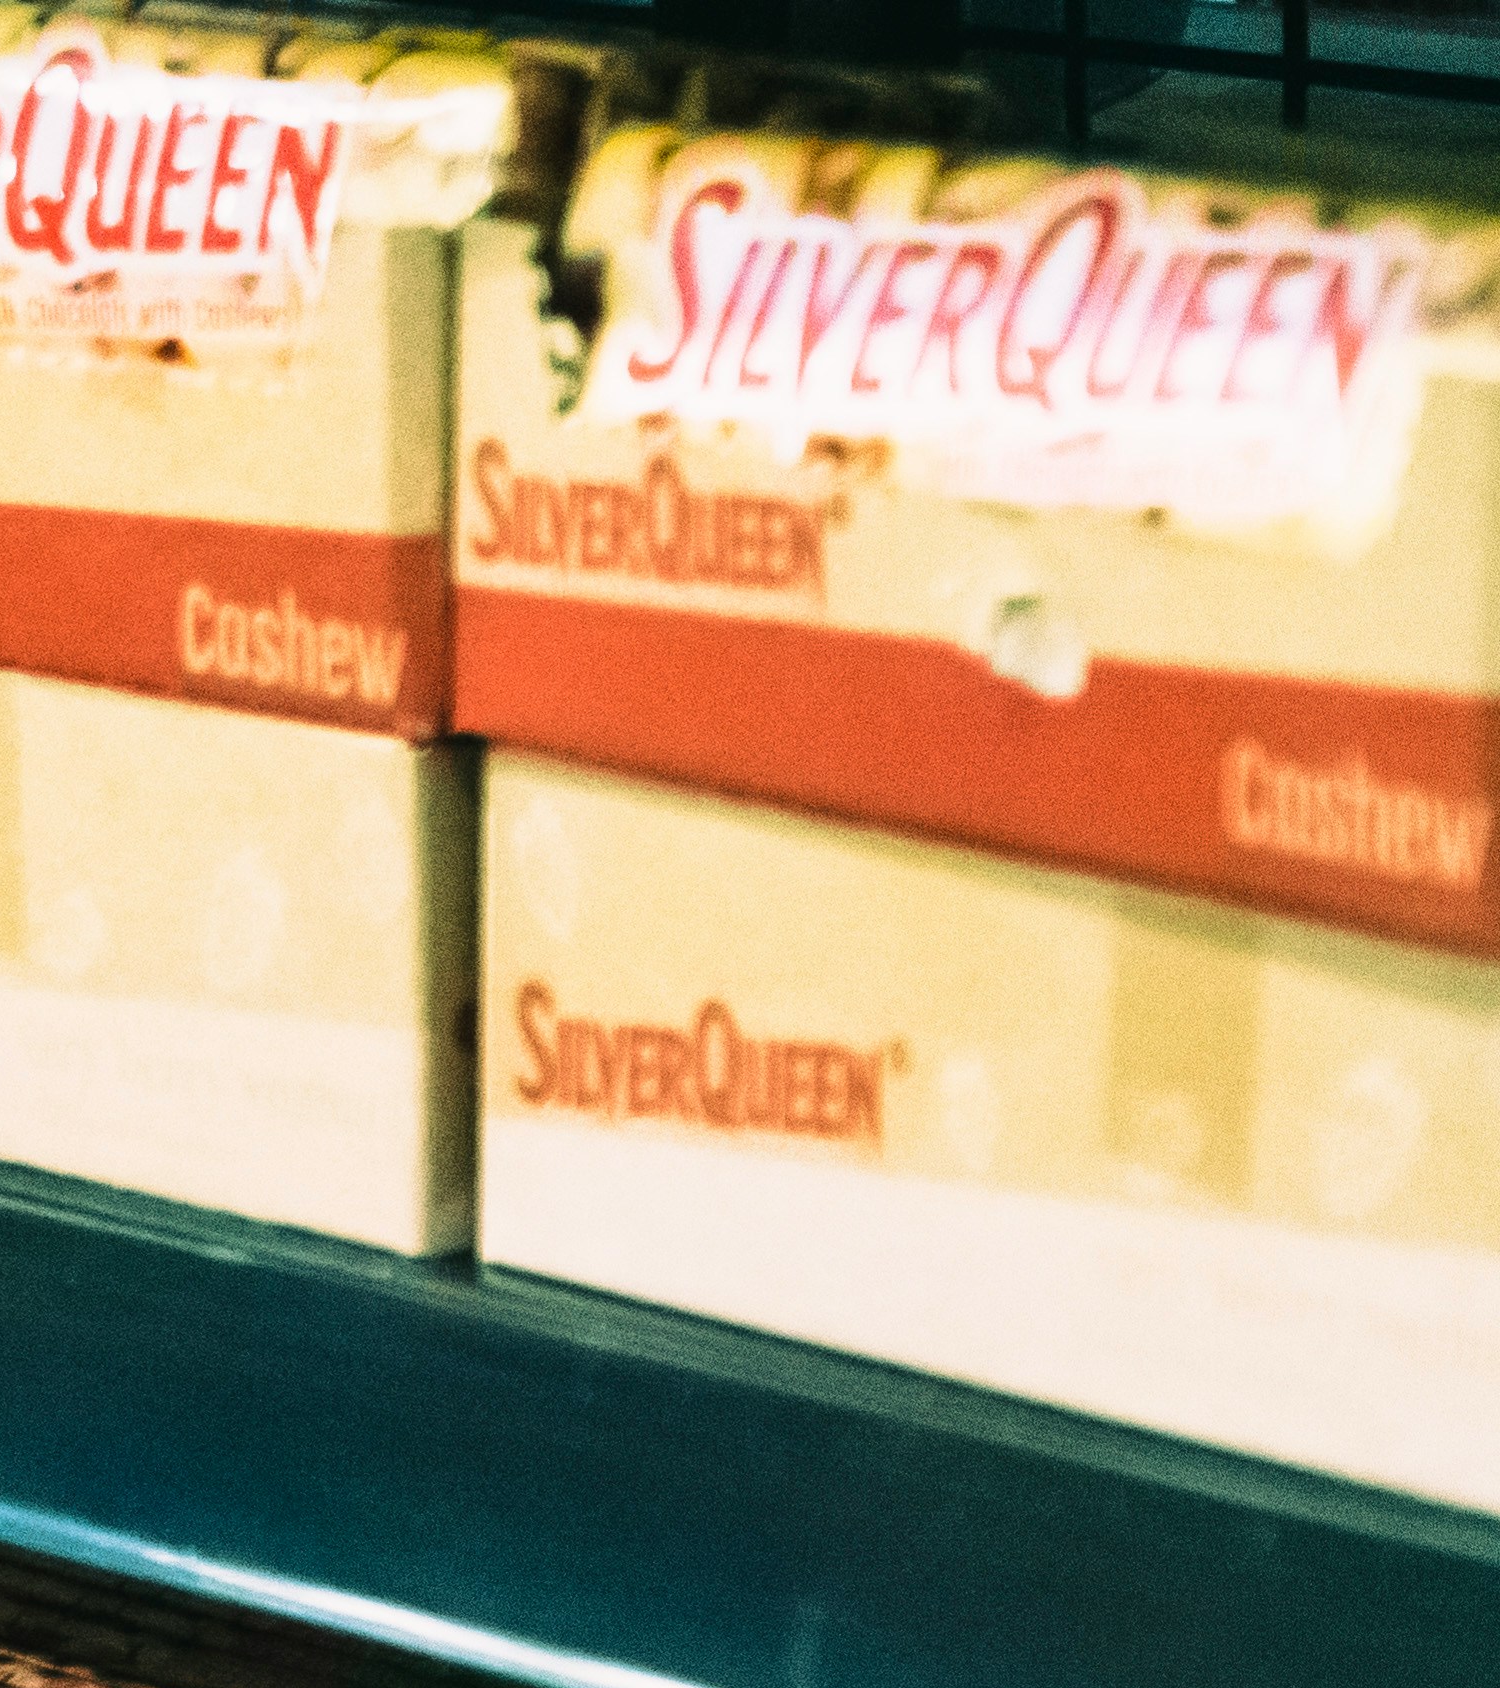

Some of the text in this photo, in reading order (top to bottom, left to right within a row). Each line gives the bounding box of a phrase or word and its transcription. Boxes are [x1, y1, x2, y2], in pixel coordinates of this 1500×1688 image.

[627, 176, 1400, 412] SILVERQUEEN
[177, 584, 409, 705] Cashew
[1222, 737, 1493, 887] Cashew
[514, 977, 886, 1143] SILVERQUEEN
